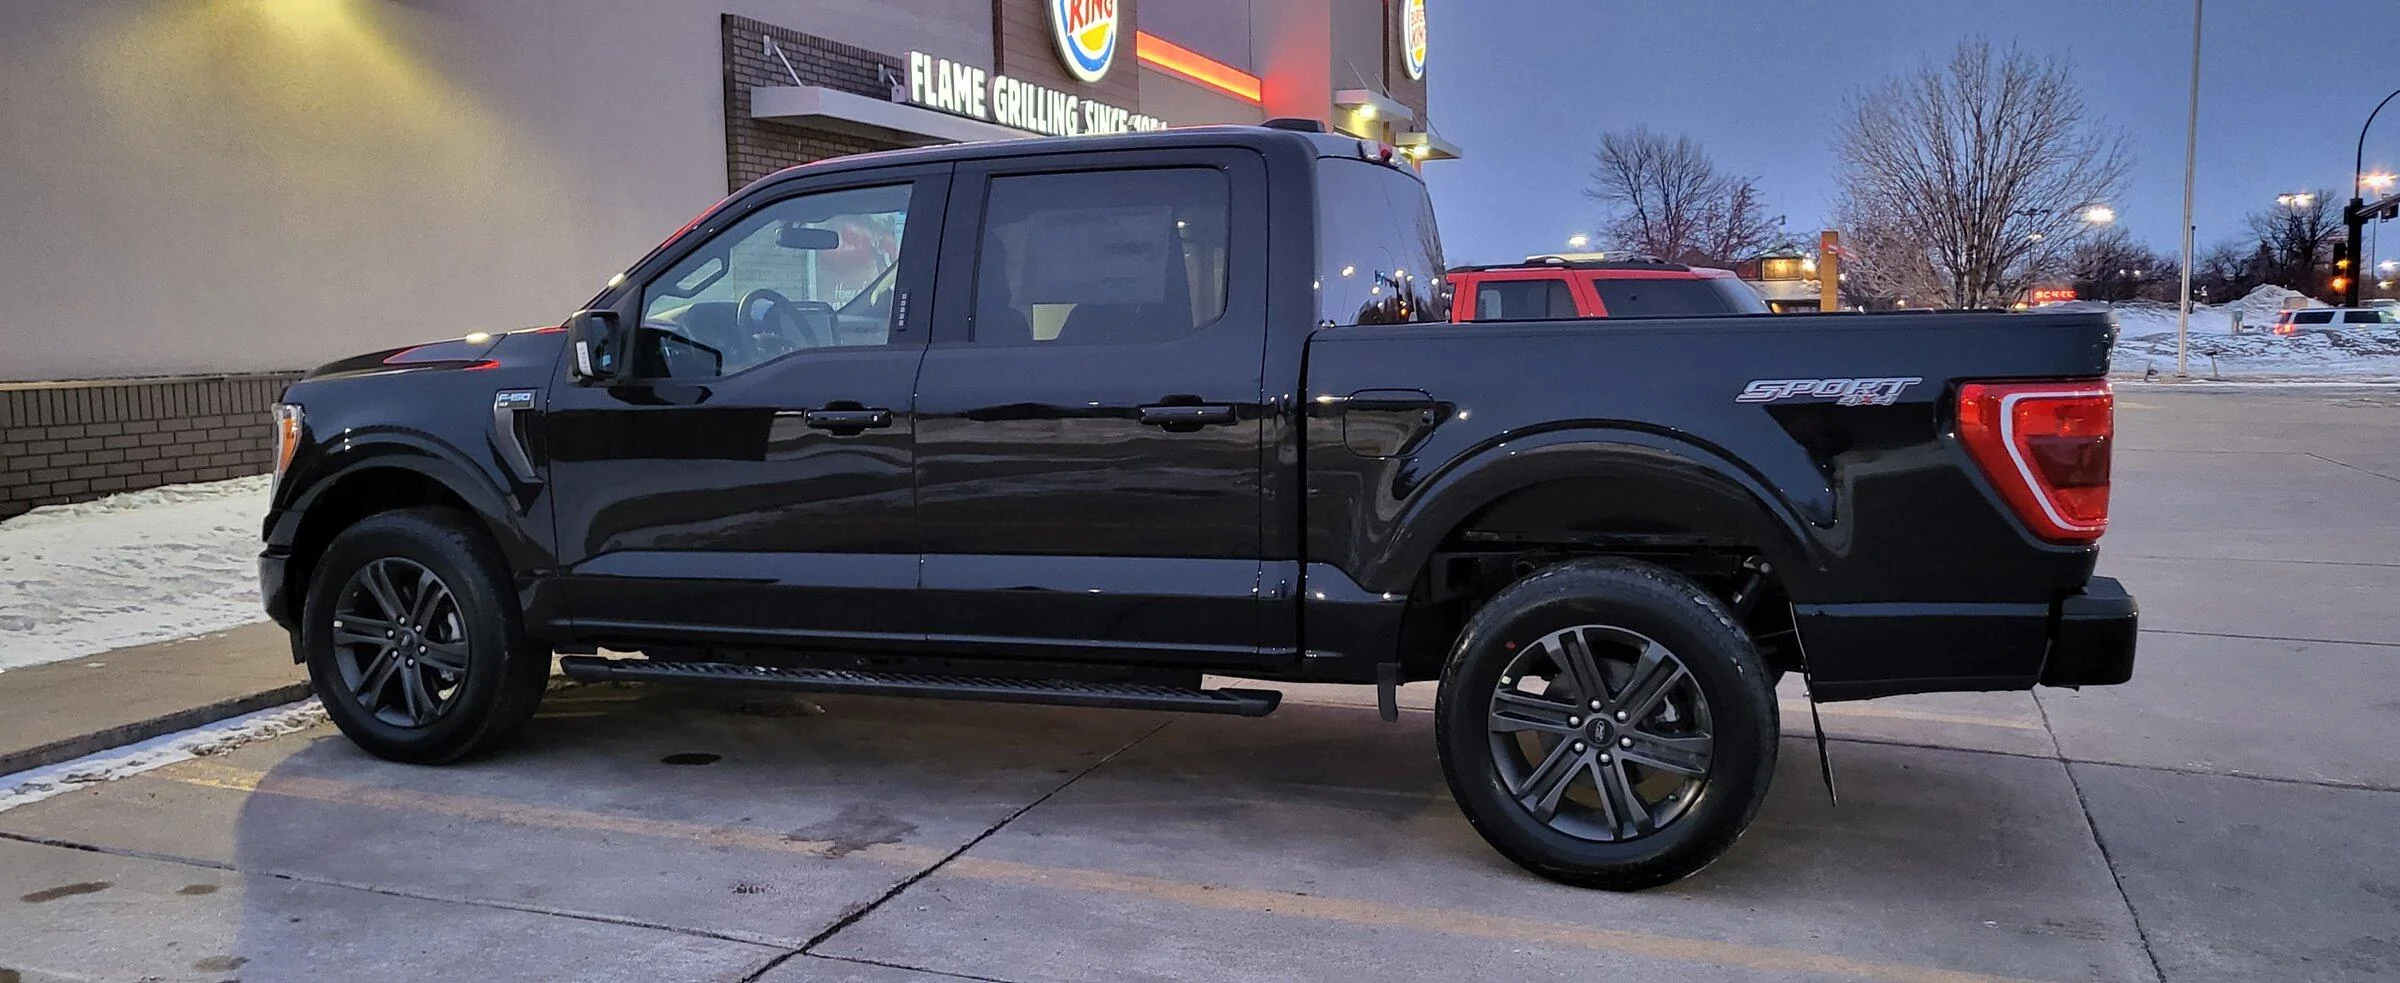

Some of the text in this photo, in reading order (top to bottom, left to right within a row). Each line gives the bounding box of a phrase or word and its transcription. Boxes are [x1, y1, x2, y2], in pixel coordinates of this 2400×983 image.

[1069, 0, 1113, 33] KING
[909, 50, 1129, 136] FLAME GRILLING SINCE
[498, 393, 531, 401] F-150
[1735, 377, 1923, 403] SPORT
